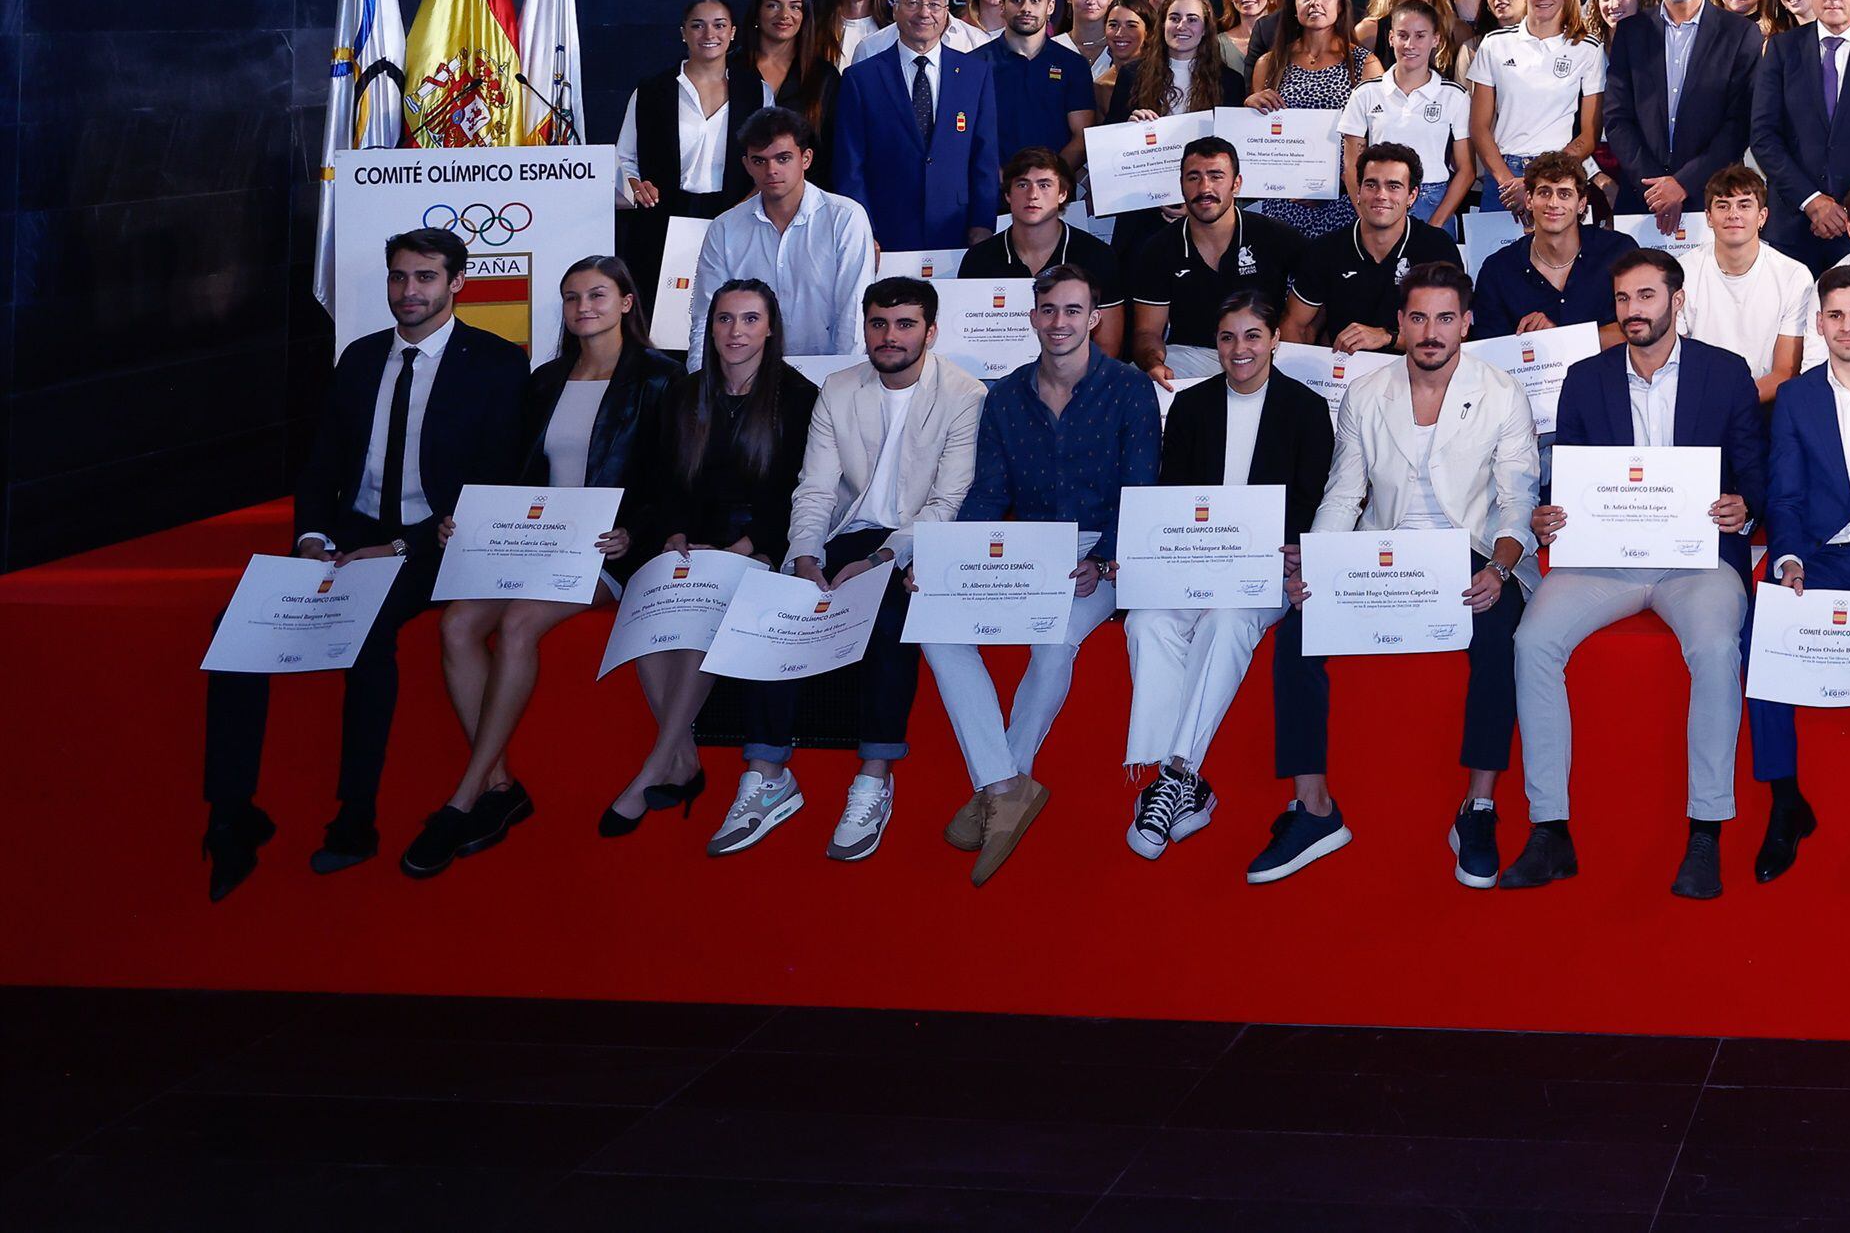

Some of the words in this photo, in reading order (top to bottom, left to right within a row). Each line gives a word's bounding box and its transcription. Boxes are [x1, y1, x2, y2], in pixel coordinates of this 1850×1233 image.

[354, 161, 422, 185] COMITÉ
[428, 160, 513, 182] OLÍMPICO
[520, 158, 596, 181] ESPAÑOL
[465, 257, 521, 275] PAÑA
[1597, 485, 1618, 493] COMITÉ
[1620, 485, 1648, 493] OLÍMPICO
[1649, 485, 1674, 493] ESPAÑOL
[1649, 504, 1667, 512] López
[514, 522, 542, 530] OLÍMPICO
[542, 522, 567, 530] ESPAÑOL
[1163, 526, 1185, 534] COMITÉ
[1186, 526, 1213, 534] OLÍMPICO
[1215, 525, 1239, 533] ESPAÑOL
[1010, 562, 1034, 570] ESPAÑOL
[1348, 570, 1370, 579] COMITÉ
[1371, 570, 1398, 578] OLÍMPICO
[1400, 570, 1425, 578] ESPAÑOL
[662, 582, 691, 590] OLÍMPICO
[692, 582, 719, 590] ESPAÑOL
[1366, 590, 1382, 598] Hugo
[1410, 589, 1438, 598] Capdevila
[1799, 628, 1821, 636] COMITÉ
